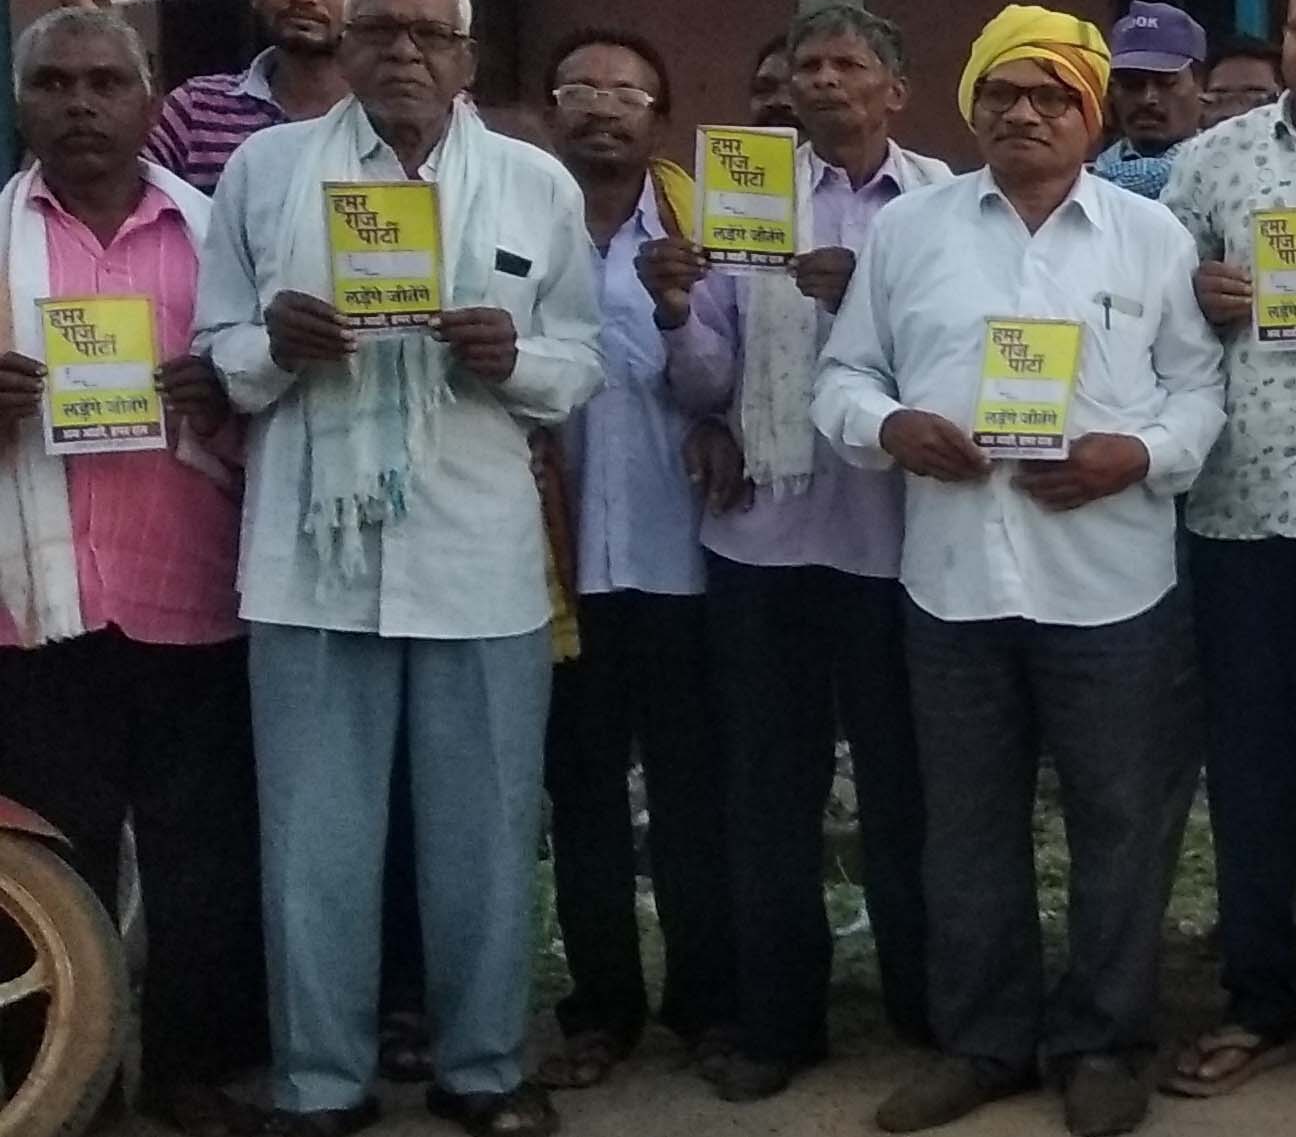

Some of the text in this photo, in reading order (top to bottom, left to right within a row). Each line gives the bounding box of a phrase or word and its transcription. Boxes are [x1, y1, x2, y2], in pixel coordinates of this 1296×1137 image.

[711, 138, 741, 155] हमर
[331, 194, 368, 213] हमर
[1259, 219, 1287, 236] हमर
[51, 309, 86, 327] हमर
[992, 328, 1023, 345] हमर
